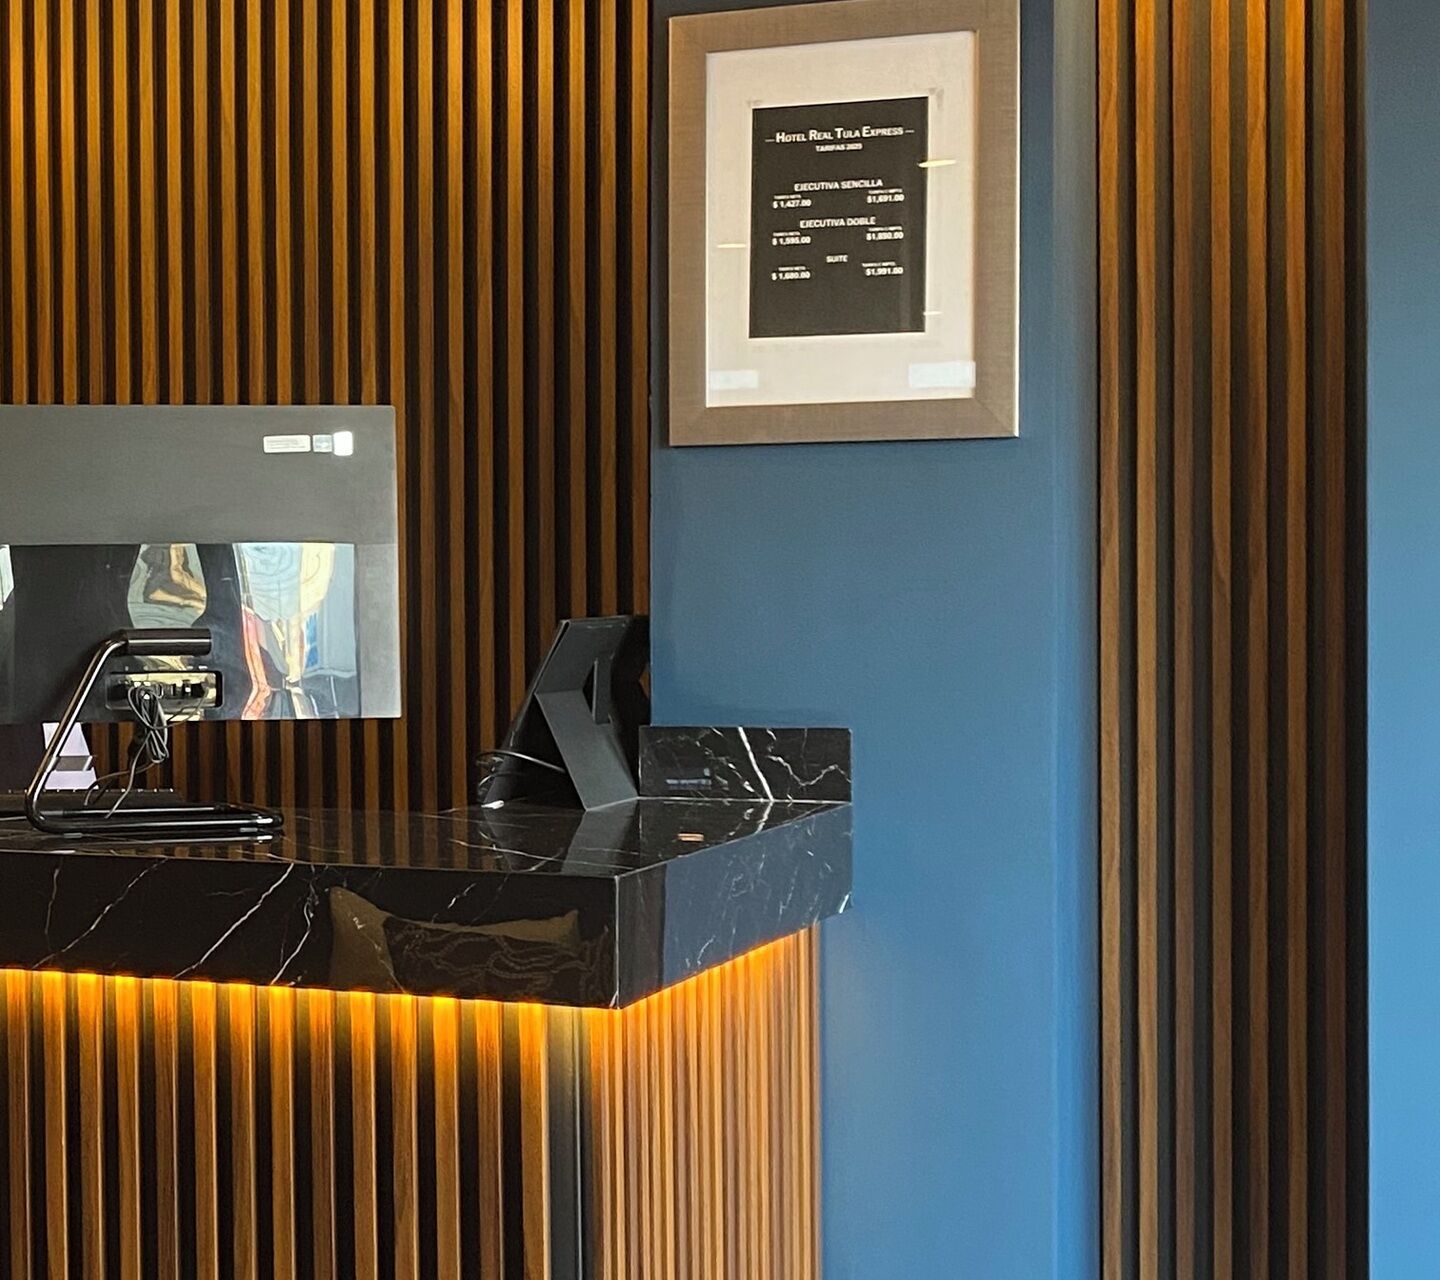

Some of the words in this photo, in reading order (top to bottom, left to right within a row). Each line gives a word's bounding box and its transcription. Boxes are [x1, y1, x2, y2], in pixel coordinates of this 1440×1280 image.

[775, 131, 807, 143] HOTEL
[809, 129, 834, 140] REAL
[834, 127, 861, 139] TULA
[862, 125, 904, 137] EXPRESS
[793, 181, 840, 192] EJECUTIVA
[841, 179, 884, 190] SENCILLA
[799, 218, 846, 228] EJECUTIVA
[846, 216, 876, 226] DOBLE
